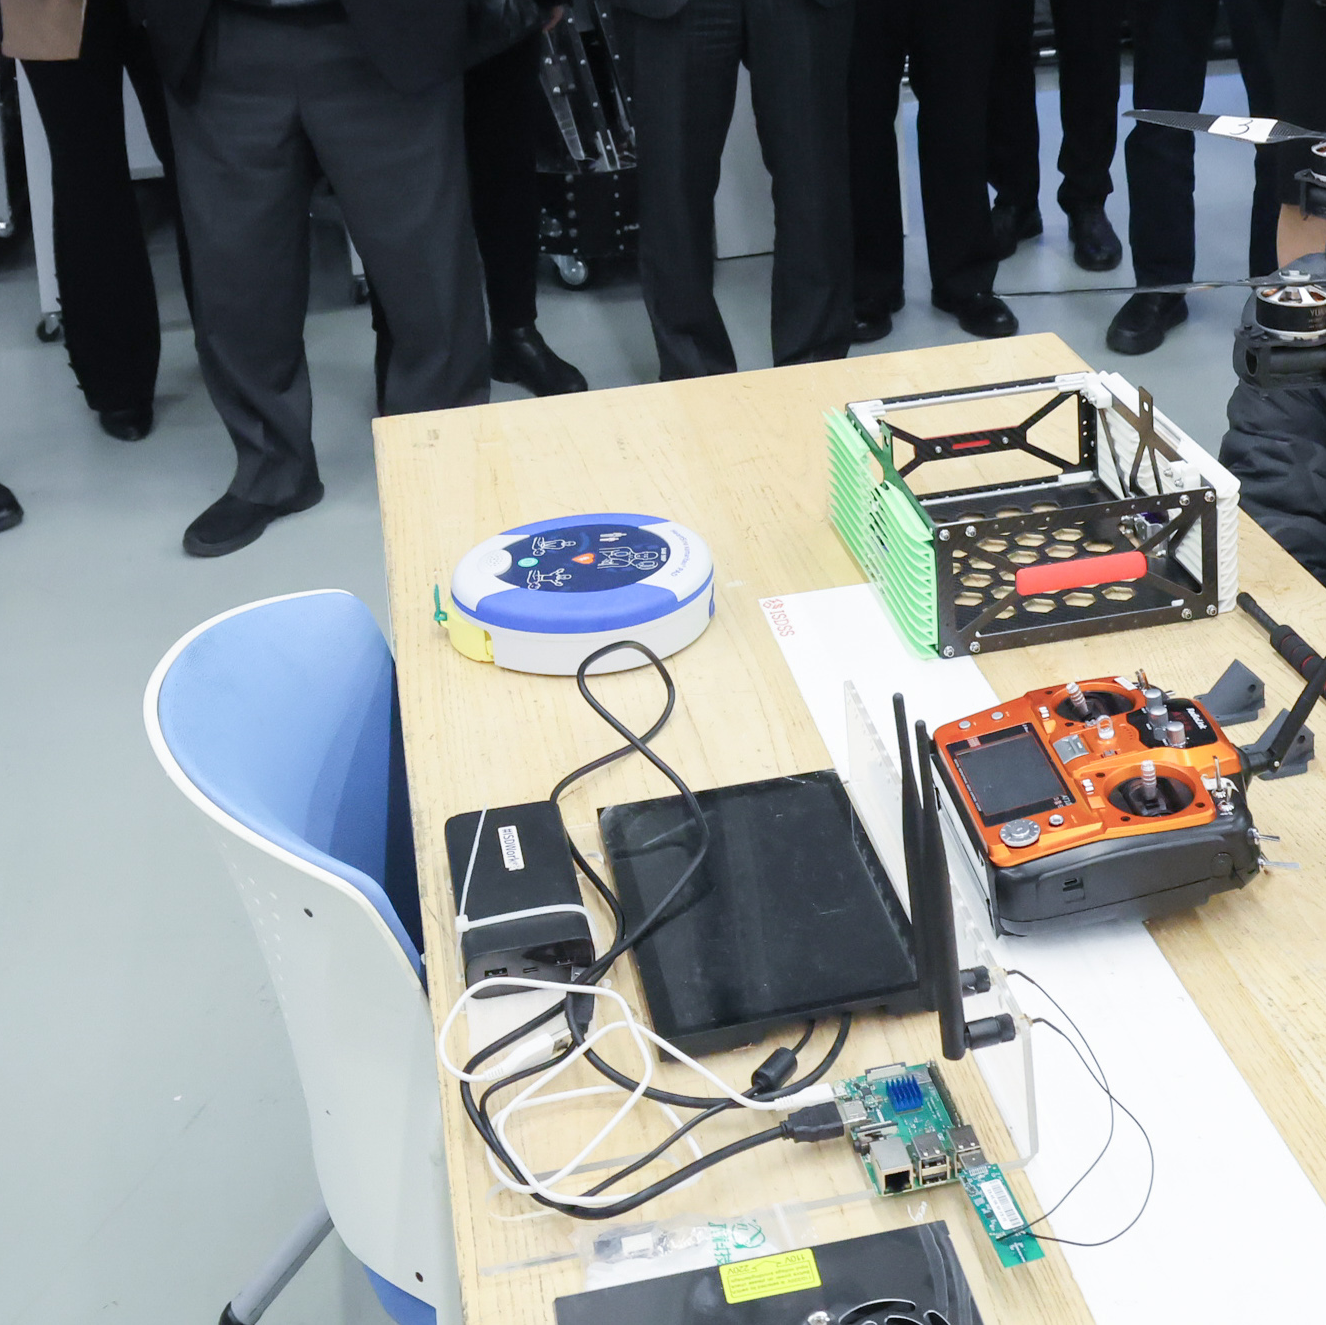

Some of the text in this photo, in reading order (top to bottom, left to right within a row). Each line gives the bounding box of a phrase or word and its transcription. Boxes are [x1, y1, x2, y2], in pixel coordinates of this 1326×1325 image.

[1229, 119, 1253, 136] 3
[769, 610, 796, 637] ISDSS
[727, 1253, 806, 1274] 110V 220V
